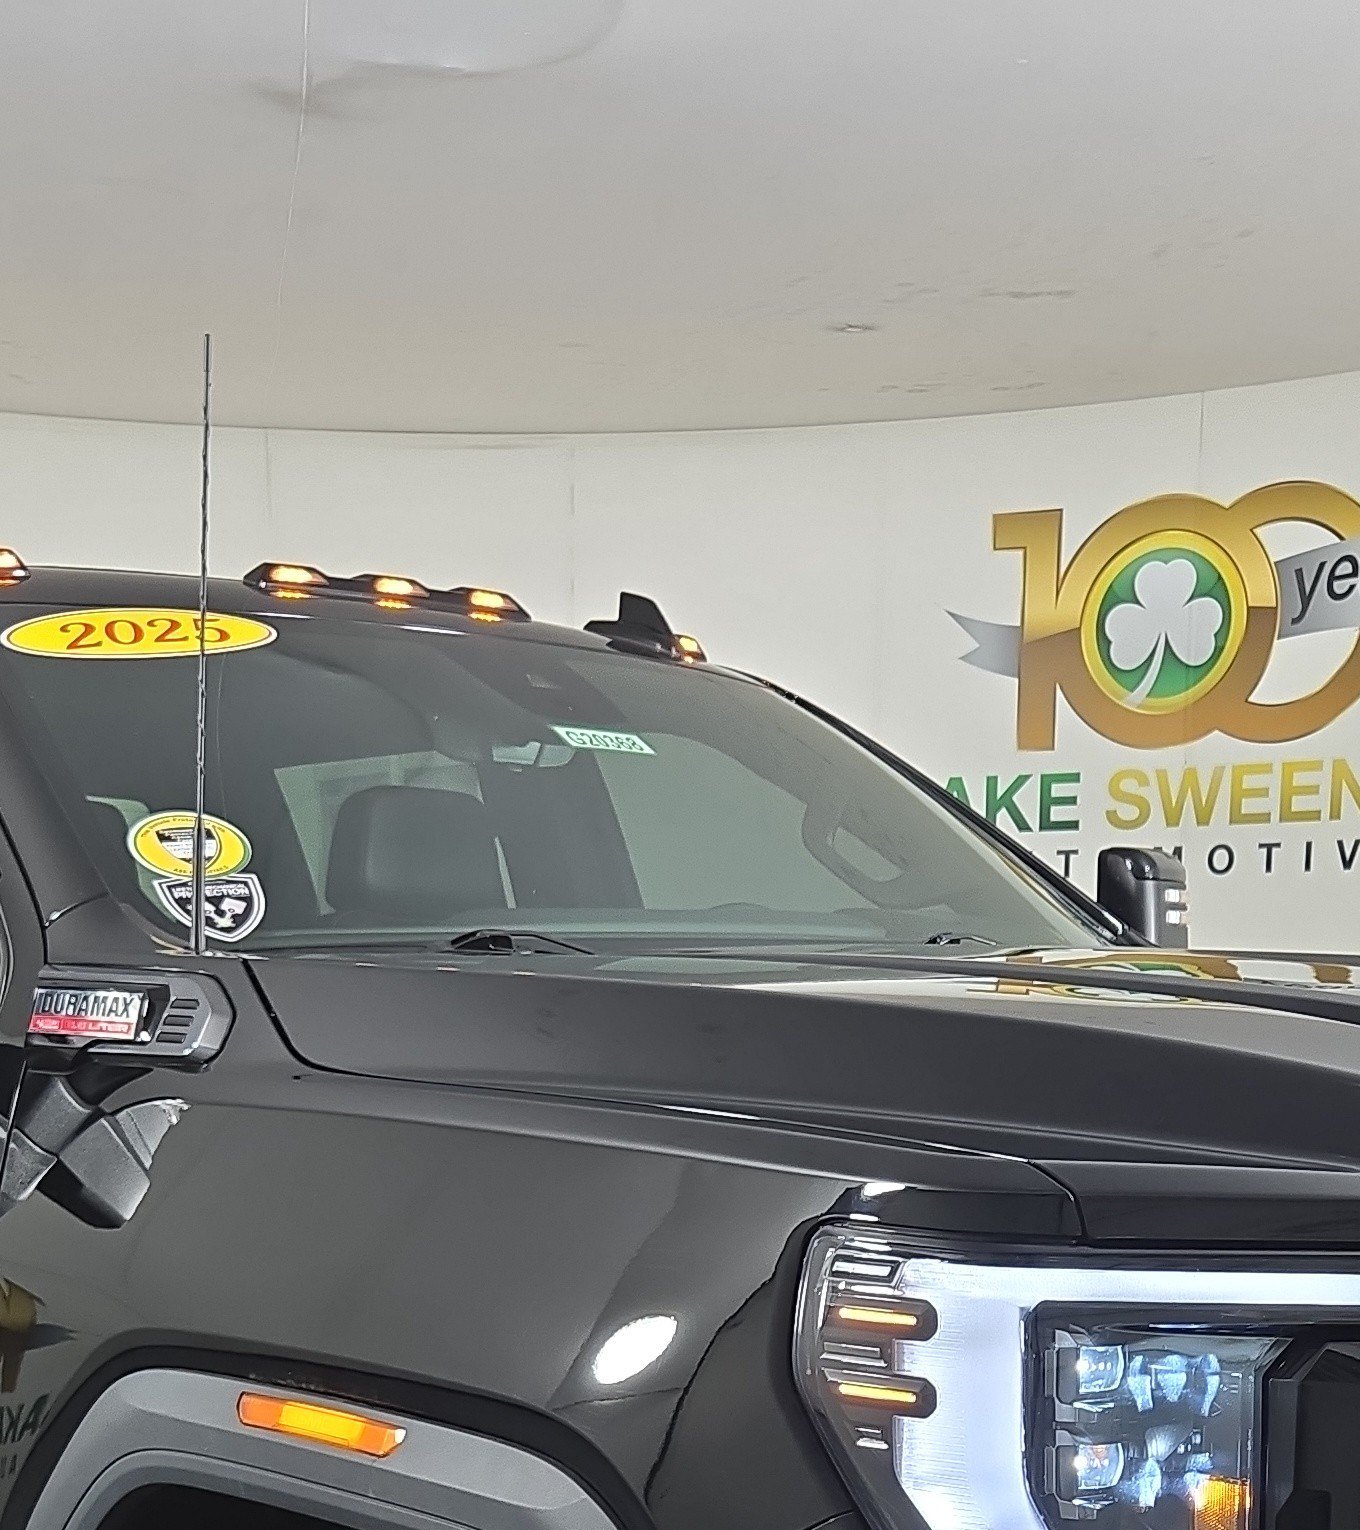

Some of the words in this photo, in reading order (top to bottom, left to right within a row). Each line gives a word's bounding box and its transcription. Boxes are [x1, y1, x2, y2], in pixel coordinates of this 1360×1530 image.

[58, 617, 231, 650] 2025
[943, 771, 1082, 833] AKE
[35, 990, 135, 1019] DURAMAX
